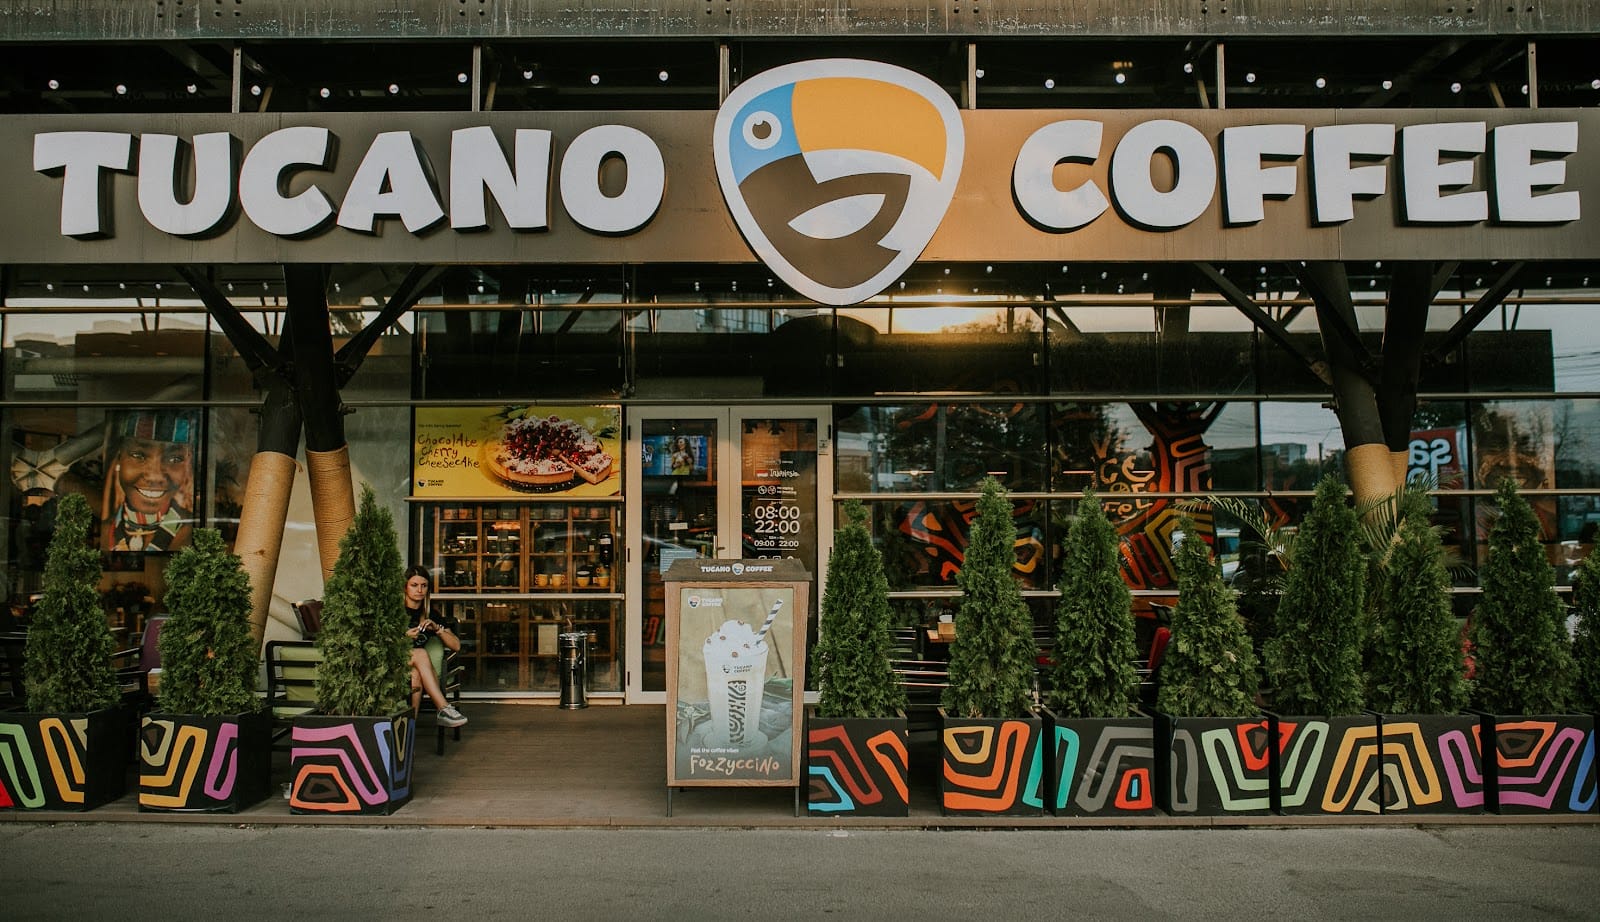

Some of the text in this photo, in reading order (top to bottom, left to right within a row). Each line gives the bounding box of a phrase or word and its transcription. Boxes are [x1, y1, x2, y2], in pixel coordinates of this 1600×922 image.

[33, 118, 1582, 240] TUCANO COFFEE
[754, 506, 800, 519] 08:00
[754, 520, 800, 533] 22:00
[701, 565, 774, 573] TUCANO COFFEE
